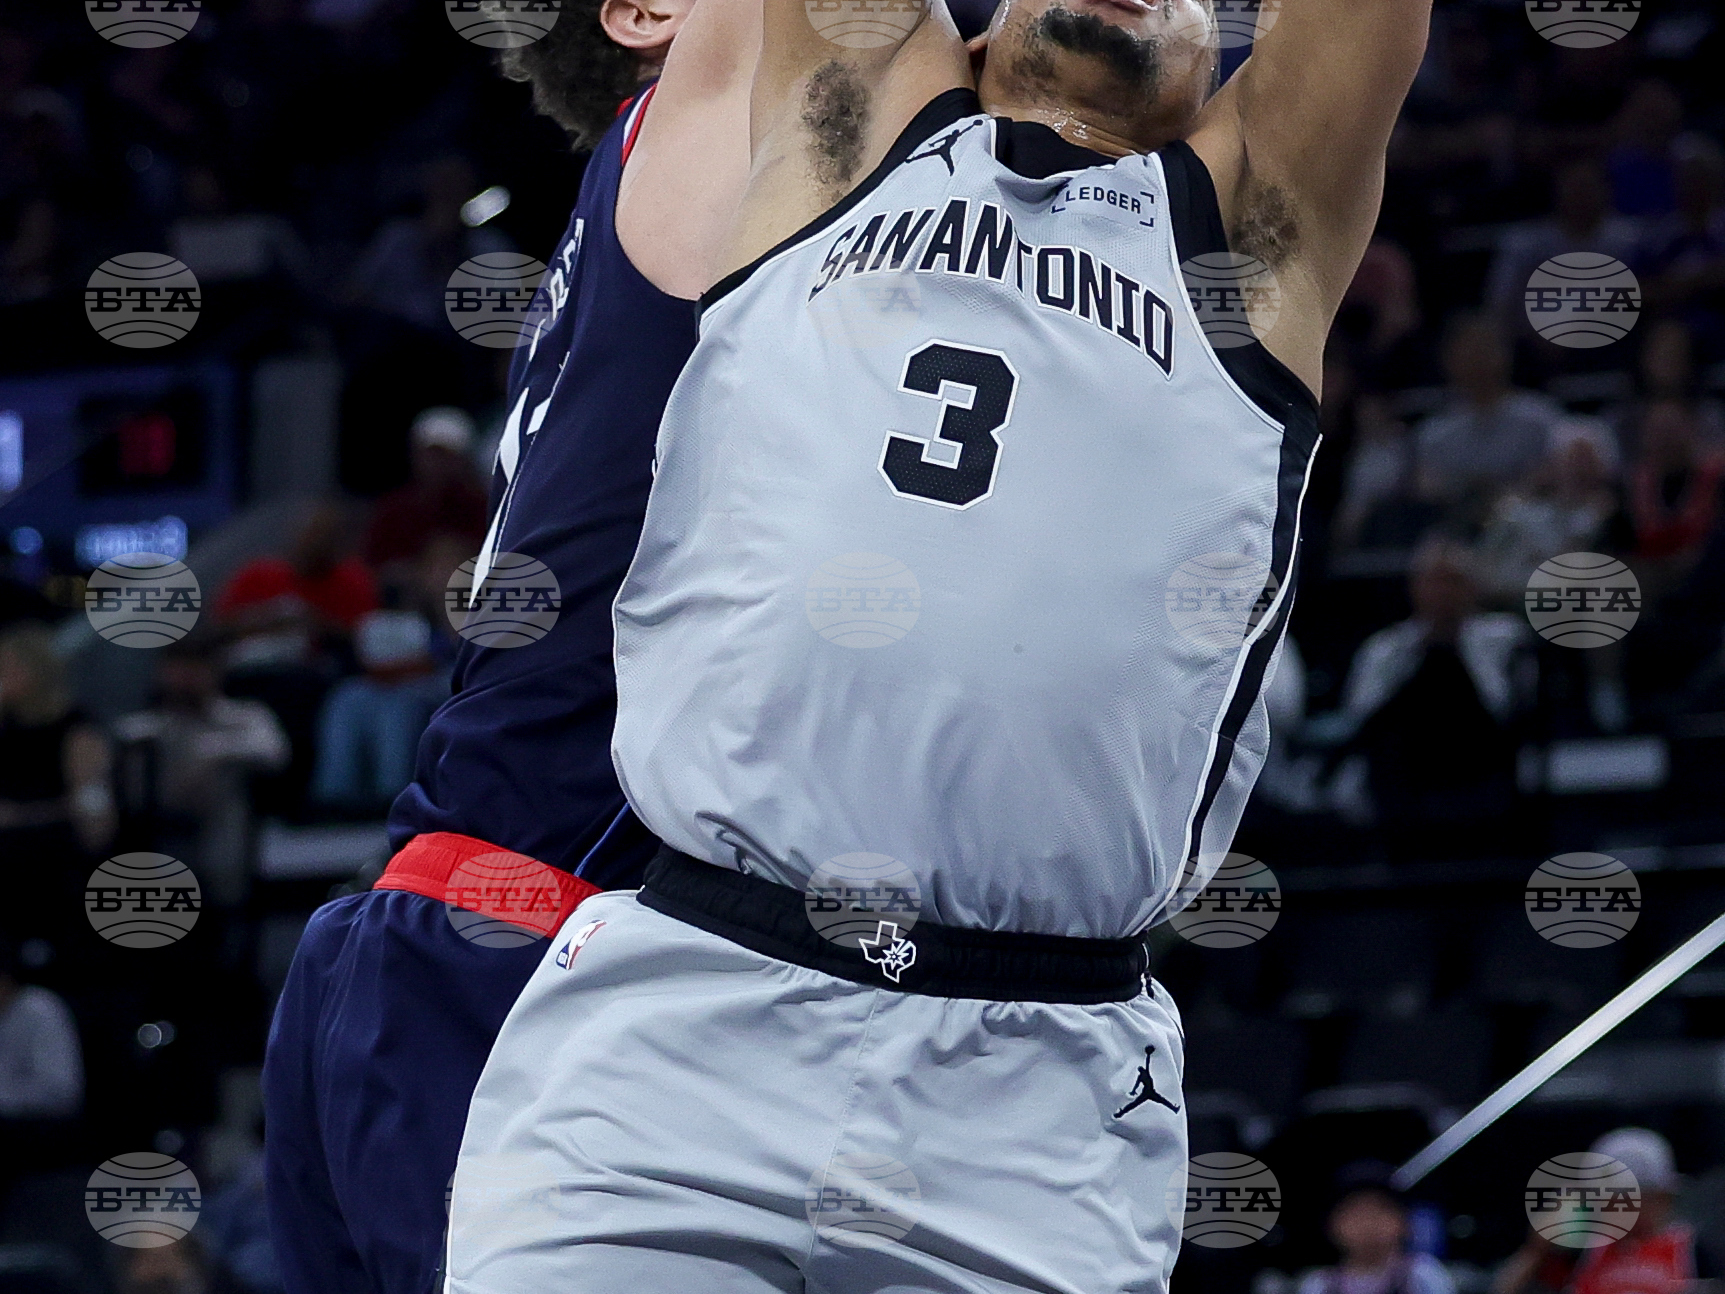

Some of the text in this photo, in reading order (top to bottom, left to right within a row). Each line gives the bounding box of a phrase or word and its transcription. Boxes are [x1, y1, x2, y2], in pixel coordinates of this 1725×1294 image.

[1065, 186, 1141, 214] LEDGER
[807, 195, 1175, 381] SAN ANTONIO
[877, 338, 1021, 511] 3
